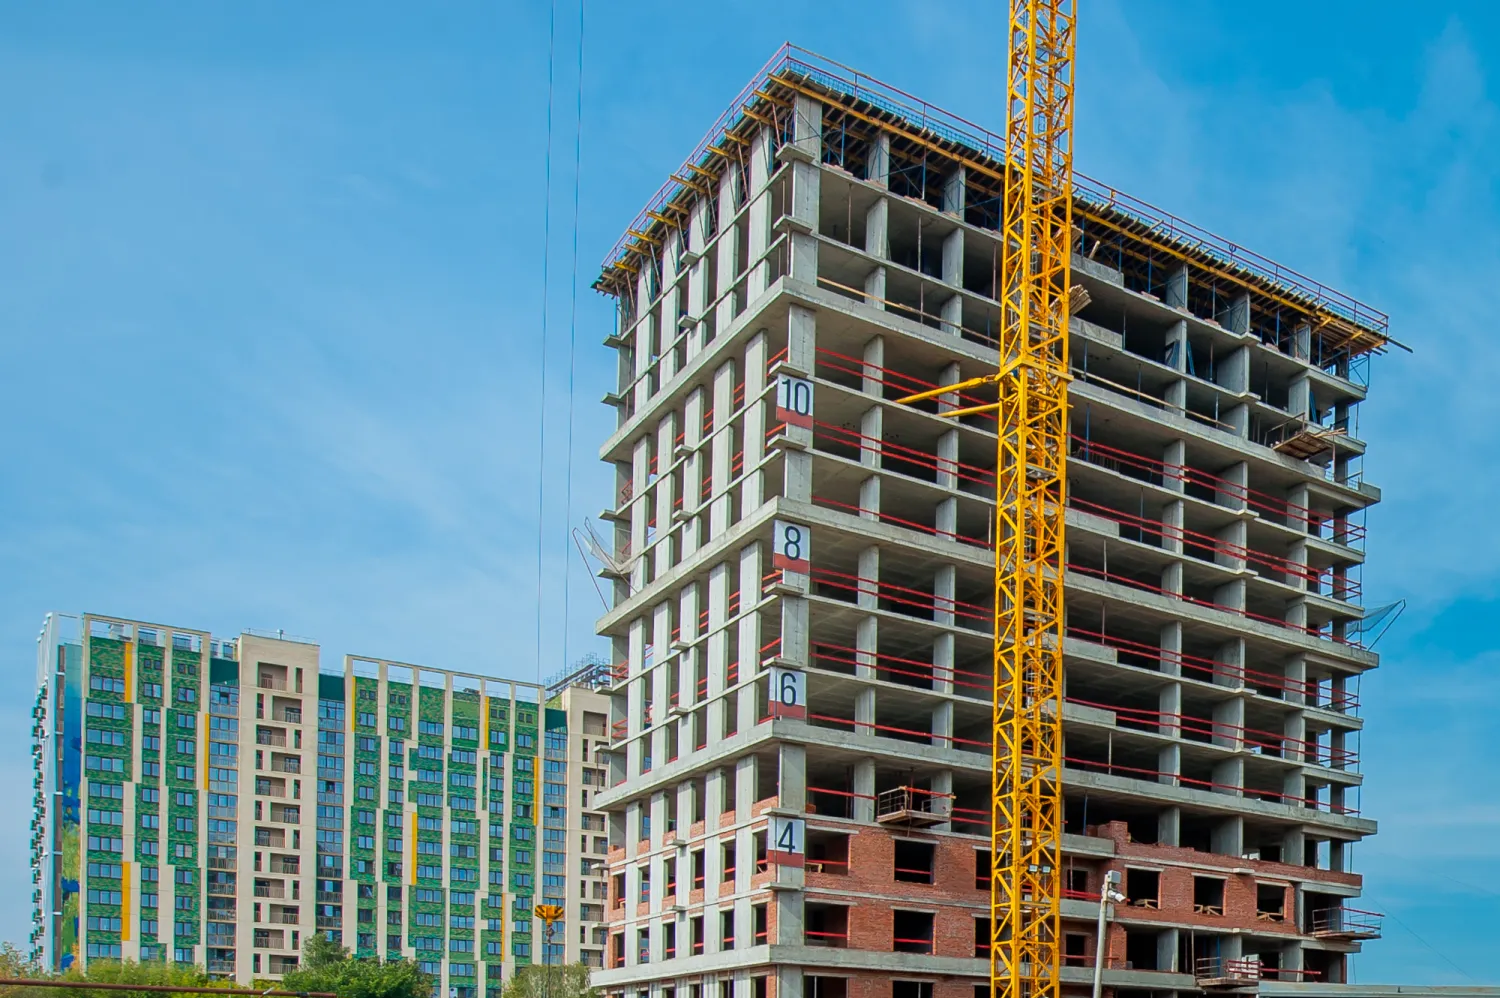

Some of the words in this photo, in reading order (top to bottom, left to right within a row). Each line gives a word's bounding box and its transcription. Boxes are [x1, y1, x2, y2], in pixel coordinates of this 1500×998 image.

[781, 378, 810, 416] 10
[784, 525, 802, 561] 8
[780, 672, 797, 707] 6
[777, 821, 796, 856] 4
